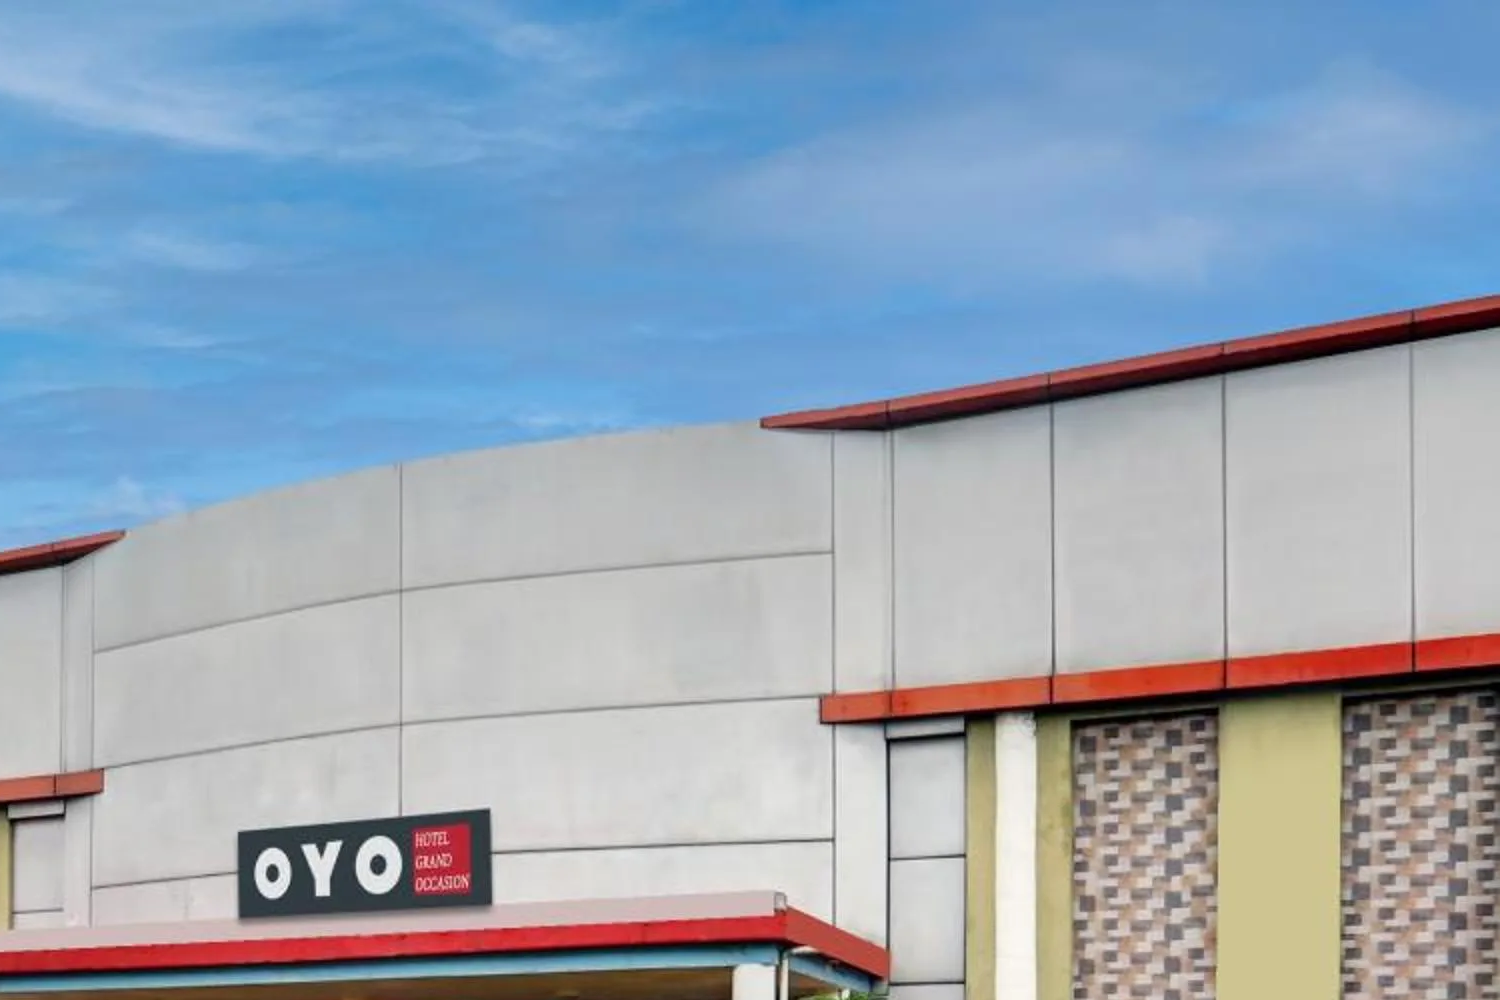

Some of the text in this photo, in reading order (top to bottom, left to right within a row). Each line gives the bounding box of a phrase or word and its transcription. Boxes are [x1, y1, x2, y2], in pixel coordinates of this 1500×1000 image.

[415, 831, 450, 848] HOTEL
[254, 835, 403, 900] OYO
[415, 853, 453, 870] GRAND
[415, 874, 470, 892] OCCASION
